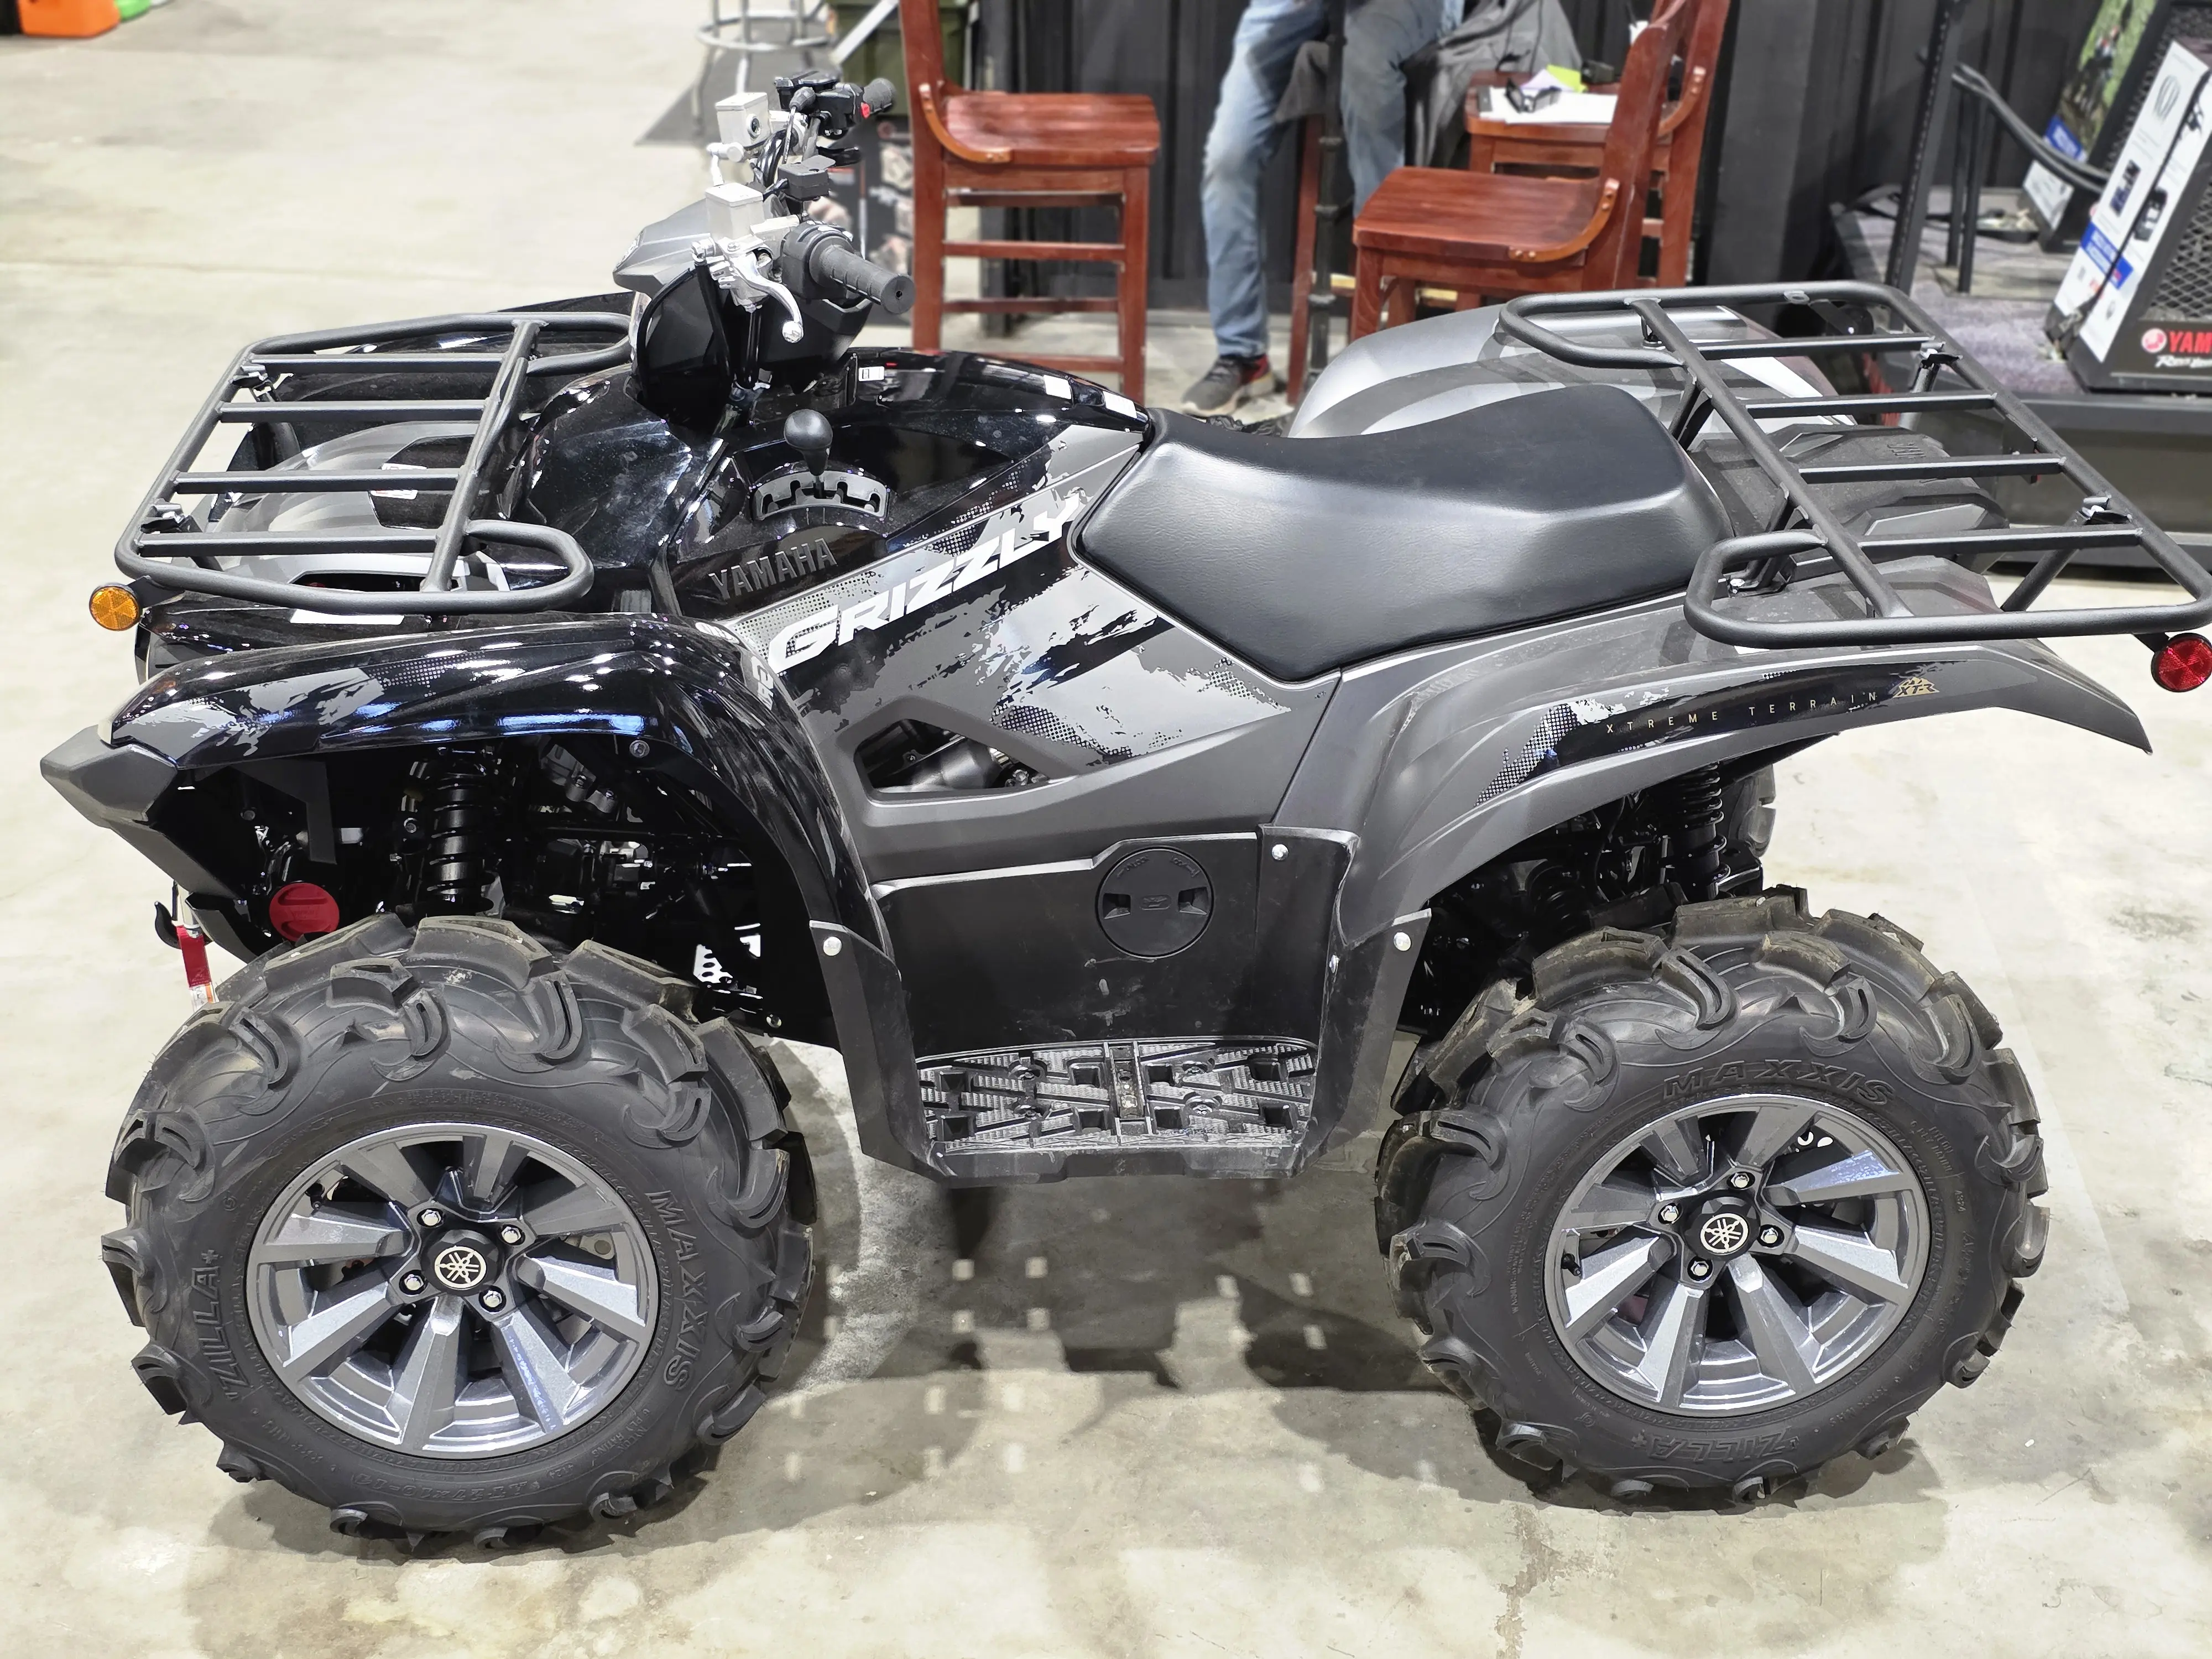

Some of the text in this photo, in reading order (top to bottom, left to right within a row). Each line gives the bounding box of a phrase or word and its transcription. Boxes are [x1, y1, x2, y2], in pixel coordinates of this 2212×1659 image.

[708, 538, 838, 599] YAMAHA
[769, 495, 1080, 674] GRIZZLY
[1606, 691, 1877, 733] XTREME TERRAIN
[1897, 684, 1936, 696] XT-R
[1663, 1059, 1895, 1105] MAXXIS
[645, 1190, 708, 1391] MAXXIS
